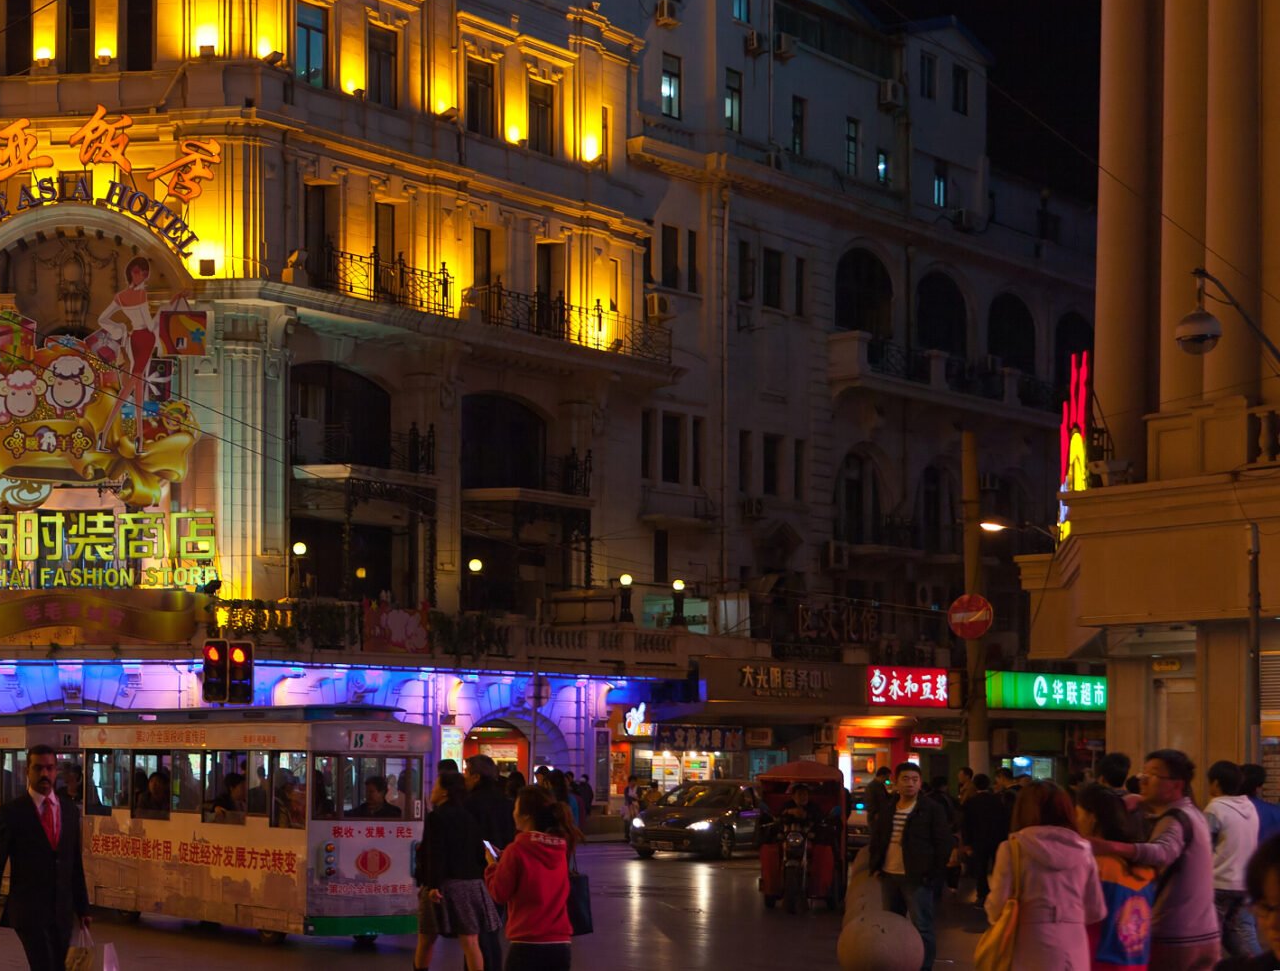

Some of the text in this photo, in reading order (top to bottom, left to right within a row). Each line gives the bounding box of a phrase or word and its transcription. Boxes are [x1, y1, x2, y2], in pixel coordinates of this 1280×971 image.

[16, 177, 93, 210] ASIA
[106, 181, 200, 259] HOTEL
[40, 567, 134, 587] FASHION
[145, 566, 218, 586] STORE
[1052, 679, 1105, 706] 华联超市
[92, 835, 297, 874] 发挥税收职能作用 促进经济发展方式转变
